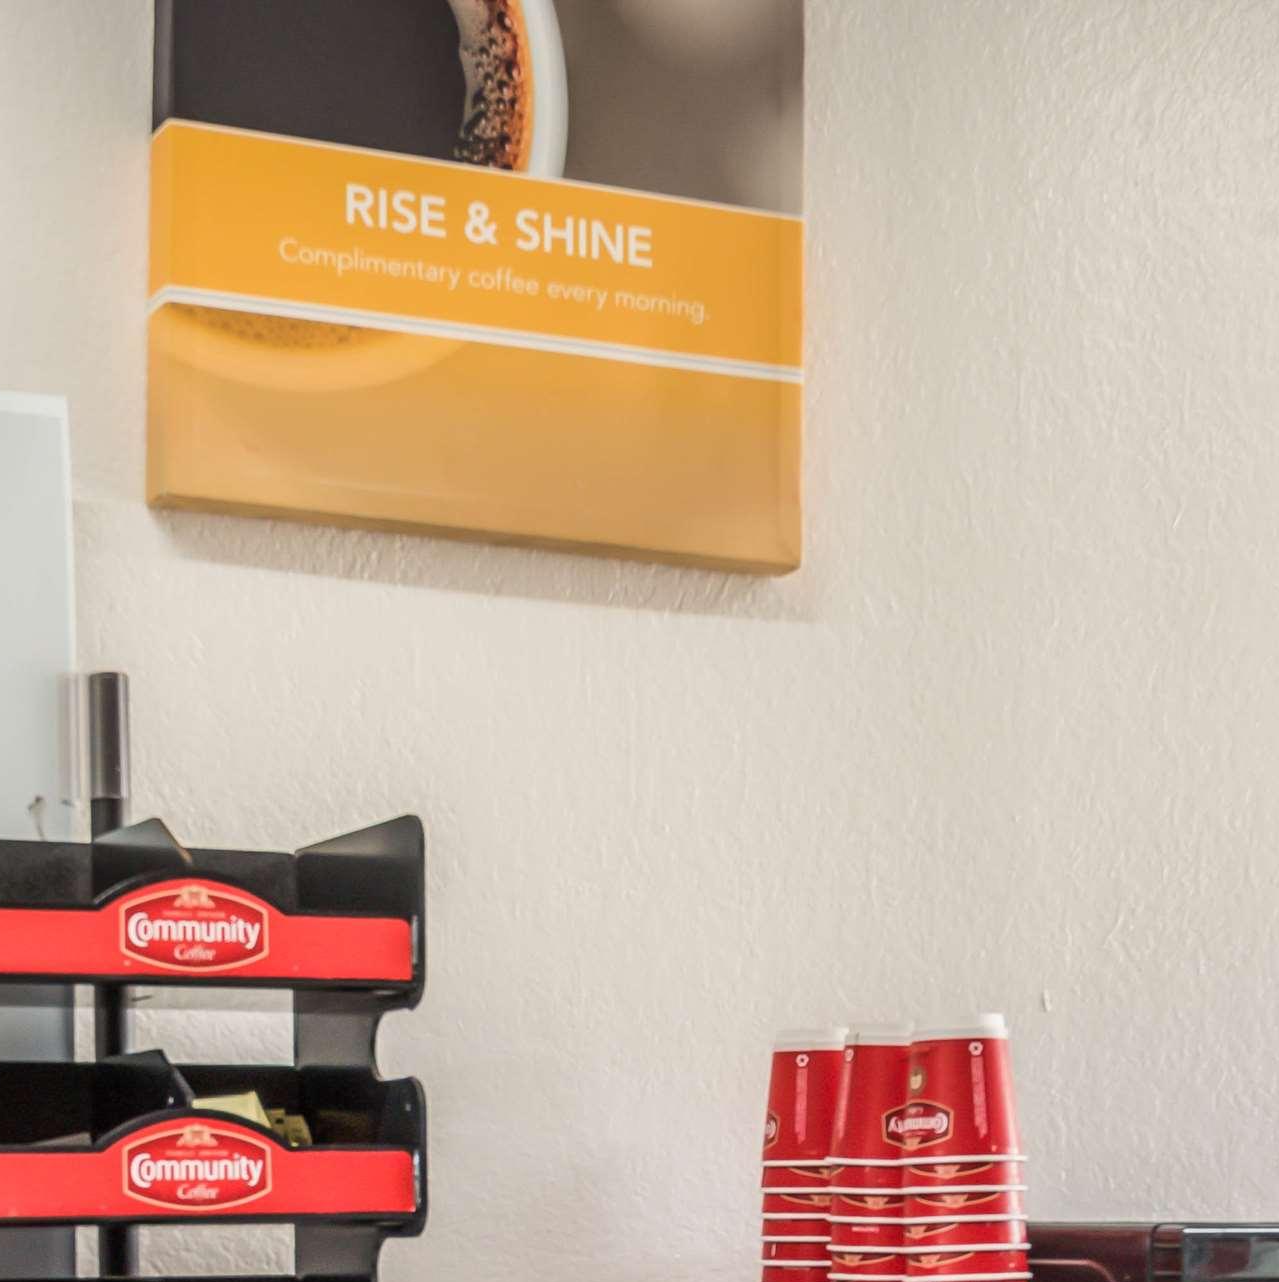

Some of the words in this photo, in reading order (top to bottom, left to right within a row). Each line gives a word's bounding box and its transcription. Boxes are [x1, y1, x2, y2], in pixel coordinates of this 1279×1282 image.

[345, 182, 447, 240] RISE
[464, 201, 497, 245] &
[515, 208, 653, 268] SHINE
[278, 238, 461, 290] Complimentary
[468, 264, 539, 297] coffee
[546, 280, 607, 311] every
[613, 290, 710, 325] morning.
[127, 911, 261, 950] Community
[130, 1152, 264, 1188] Community
